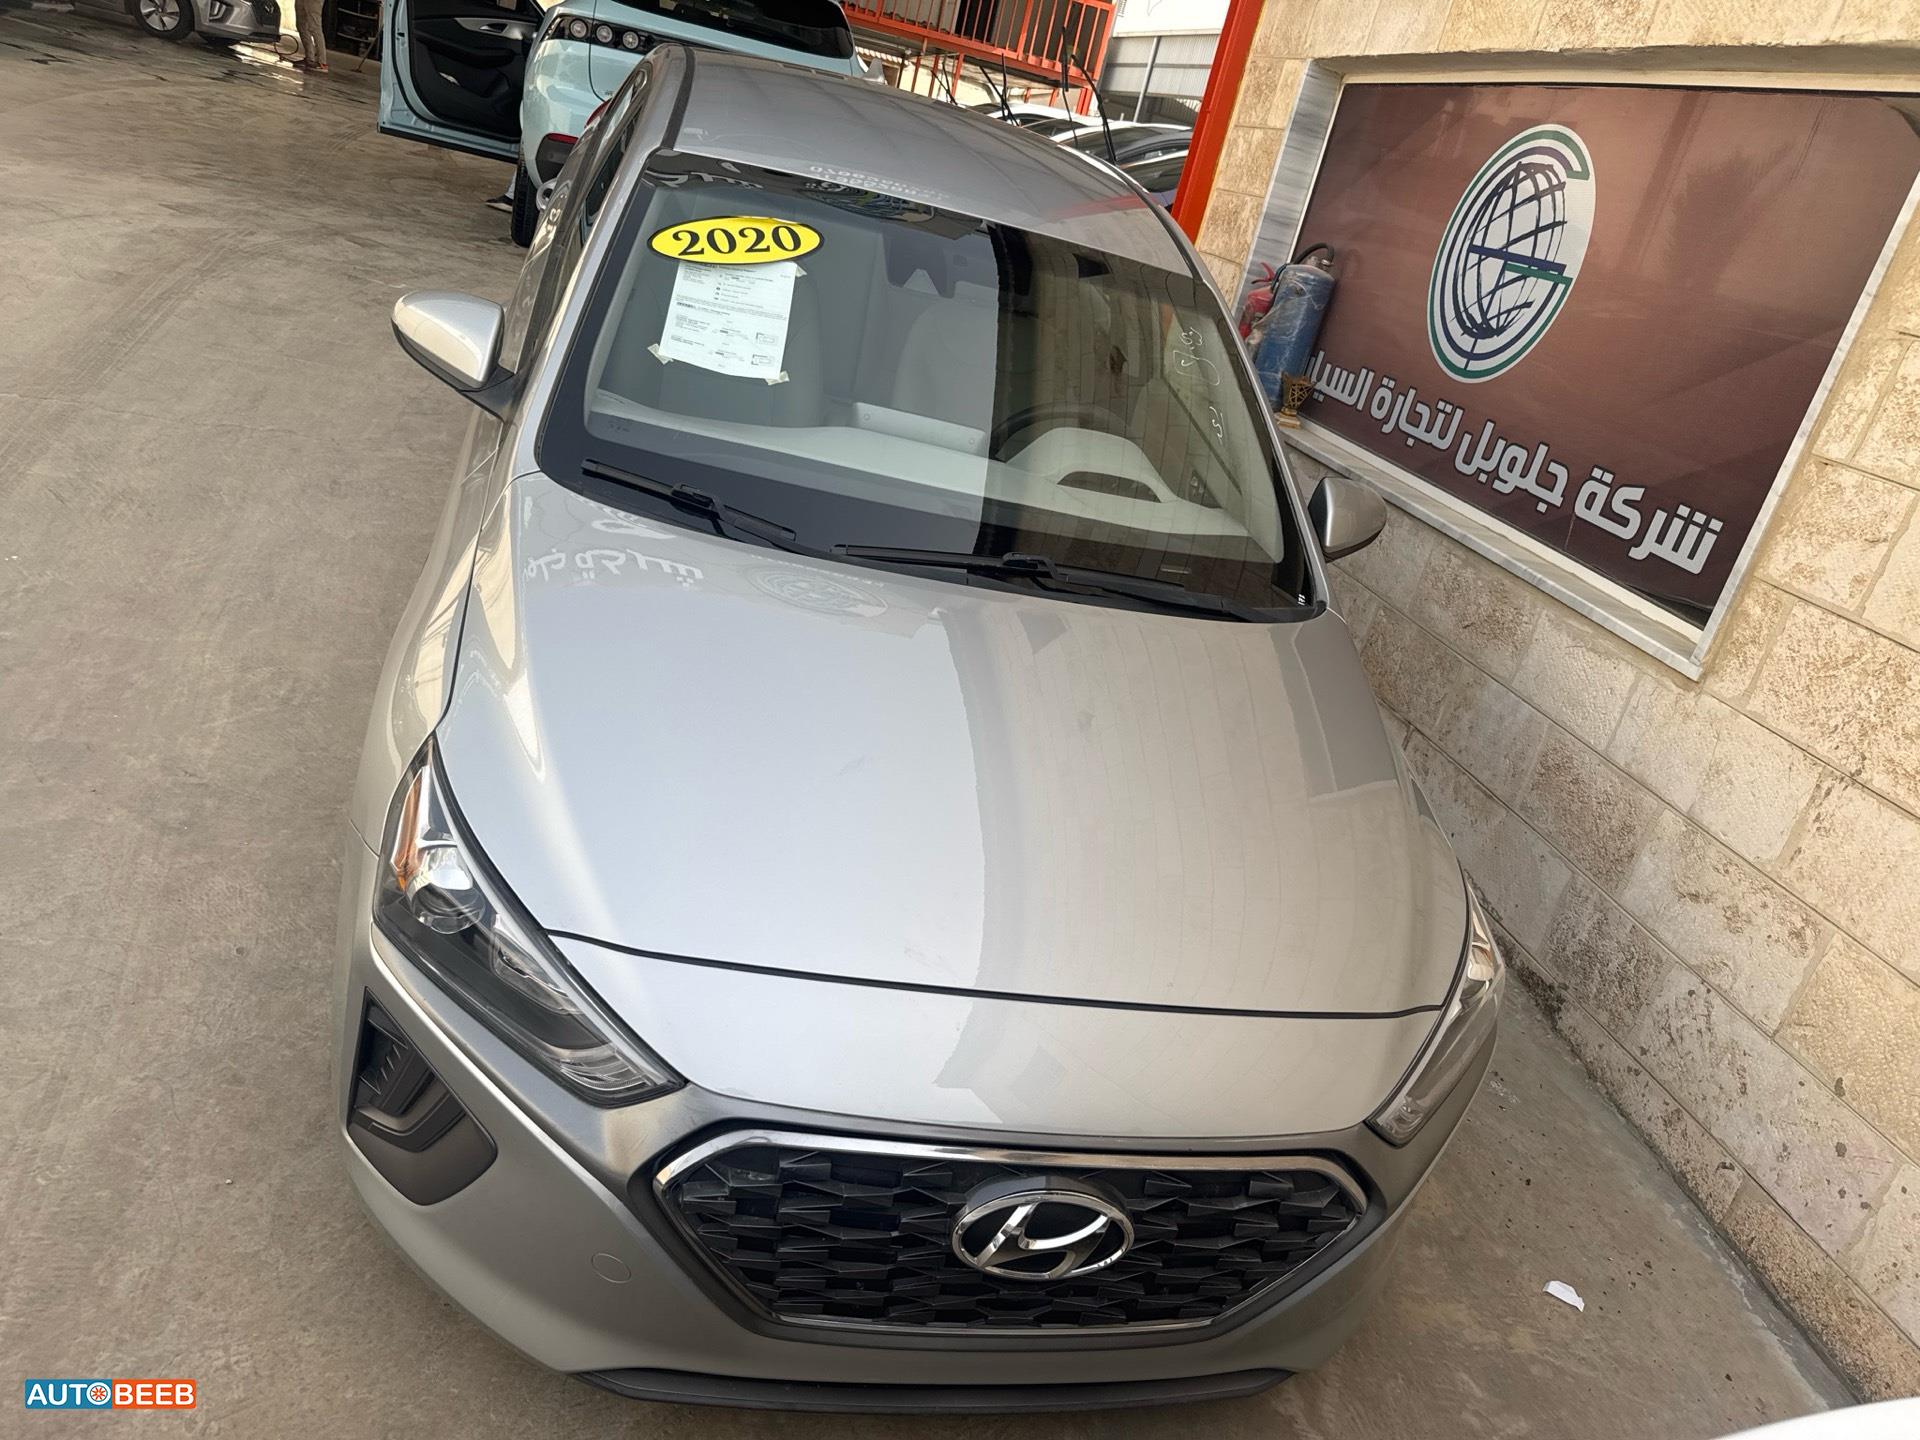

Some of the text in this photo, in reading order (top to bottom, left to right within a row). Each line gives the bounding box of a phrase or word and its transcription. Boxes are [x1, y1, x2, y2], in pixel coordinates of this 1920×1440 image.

[672, 225, 801, 256] 2020
[1370, 377, 1464, 450] لتجارة
[1454, 420, 1569, 513] جلوبل
[1574, 465, 1724, 575] شركة
